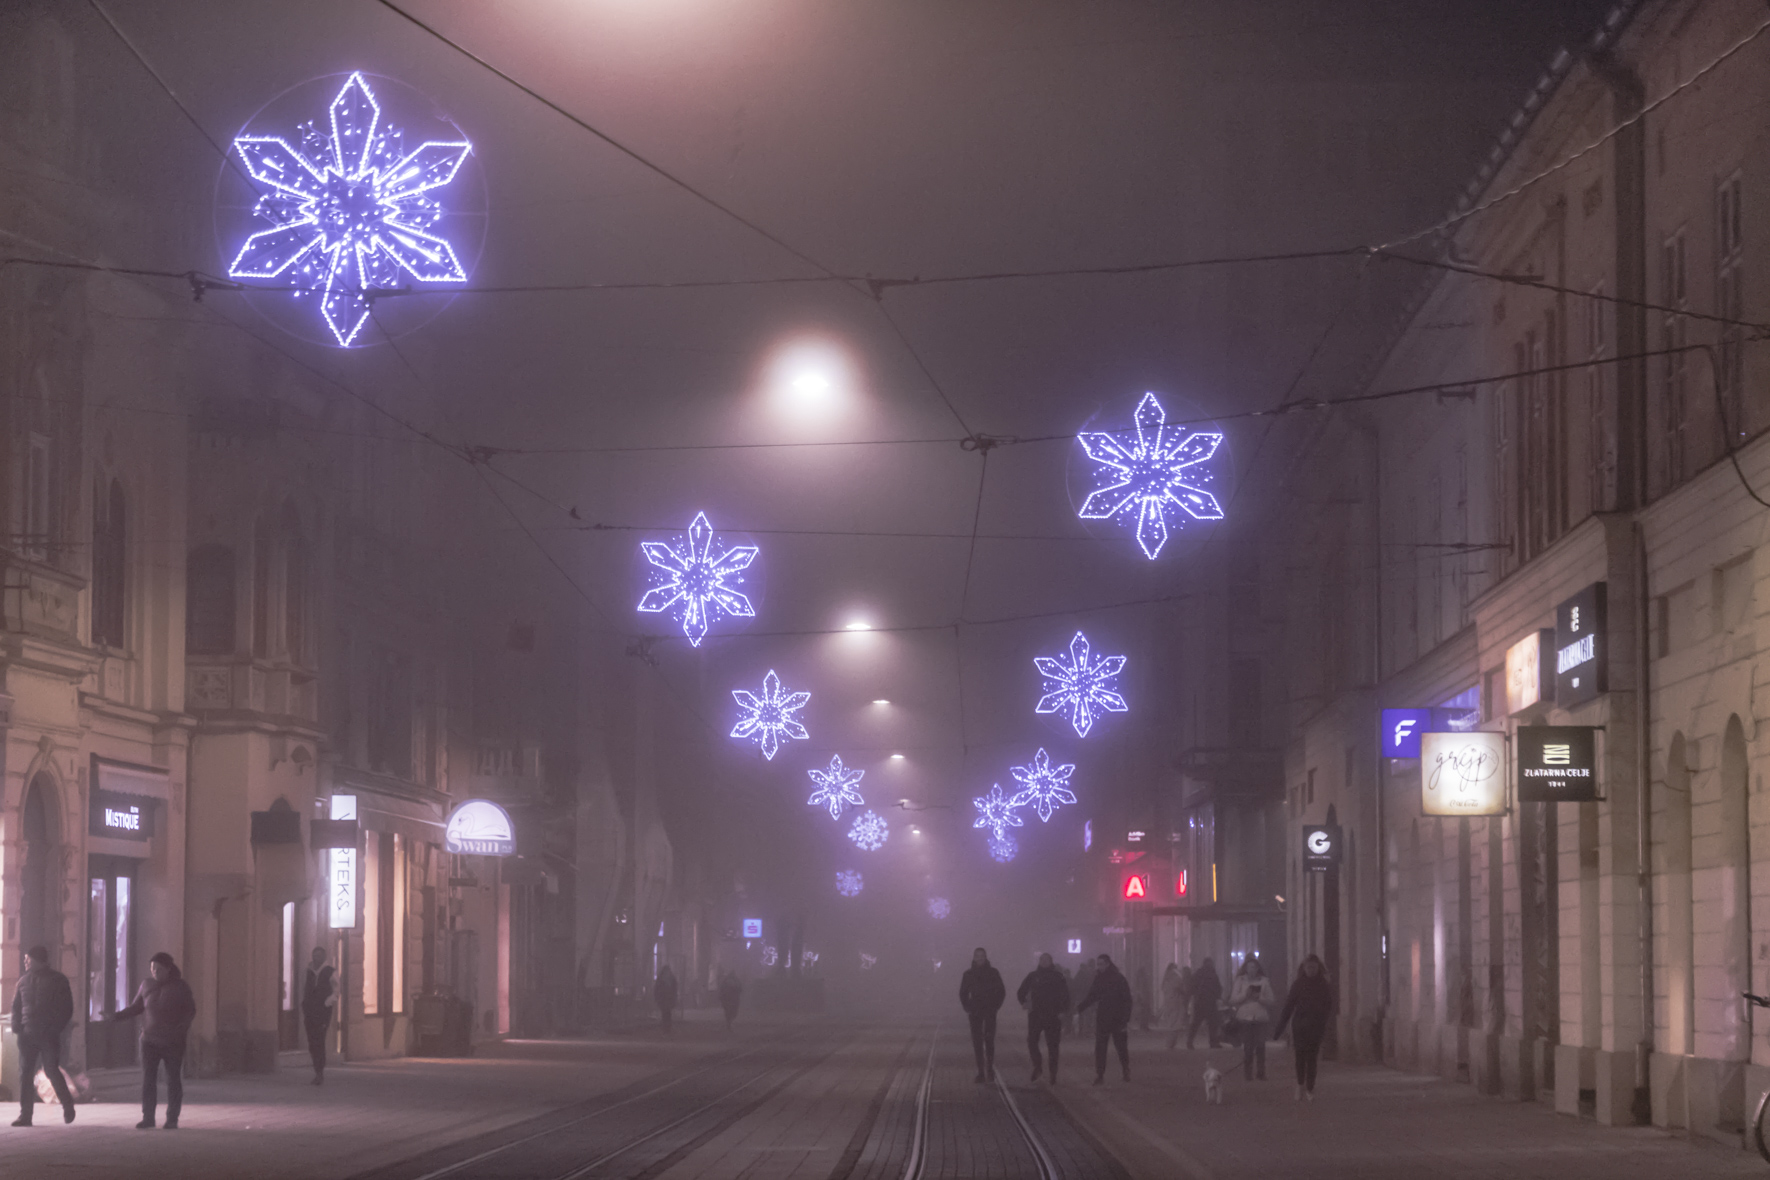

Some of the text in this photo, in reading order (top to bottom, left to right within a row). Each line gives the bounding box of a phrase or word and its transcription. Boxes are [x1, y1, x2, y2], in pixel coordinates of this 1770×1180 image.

[1524, 768, 1590, 777] ZLATARNA CELJE
[105, 808, 140, 830] MISTIQUE
[446, 831, 499, 853] Swan
[1307, 830, 1331, 855] G
[337, 812, 350, 911] VRTEKS
